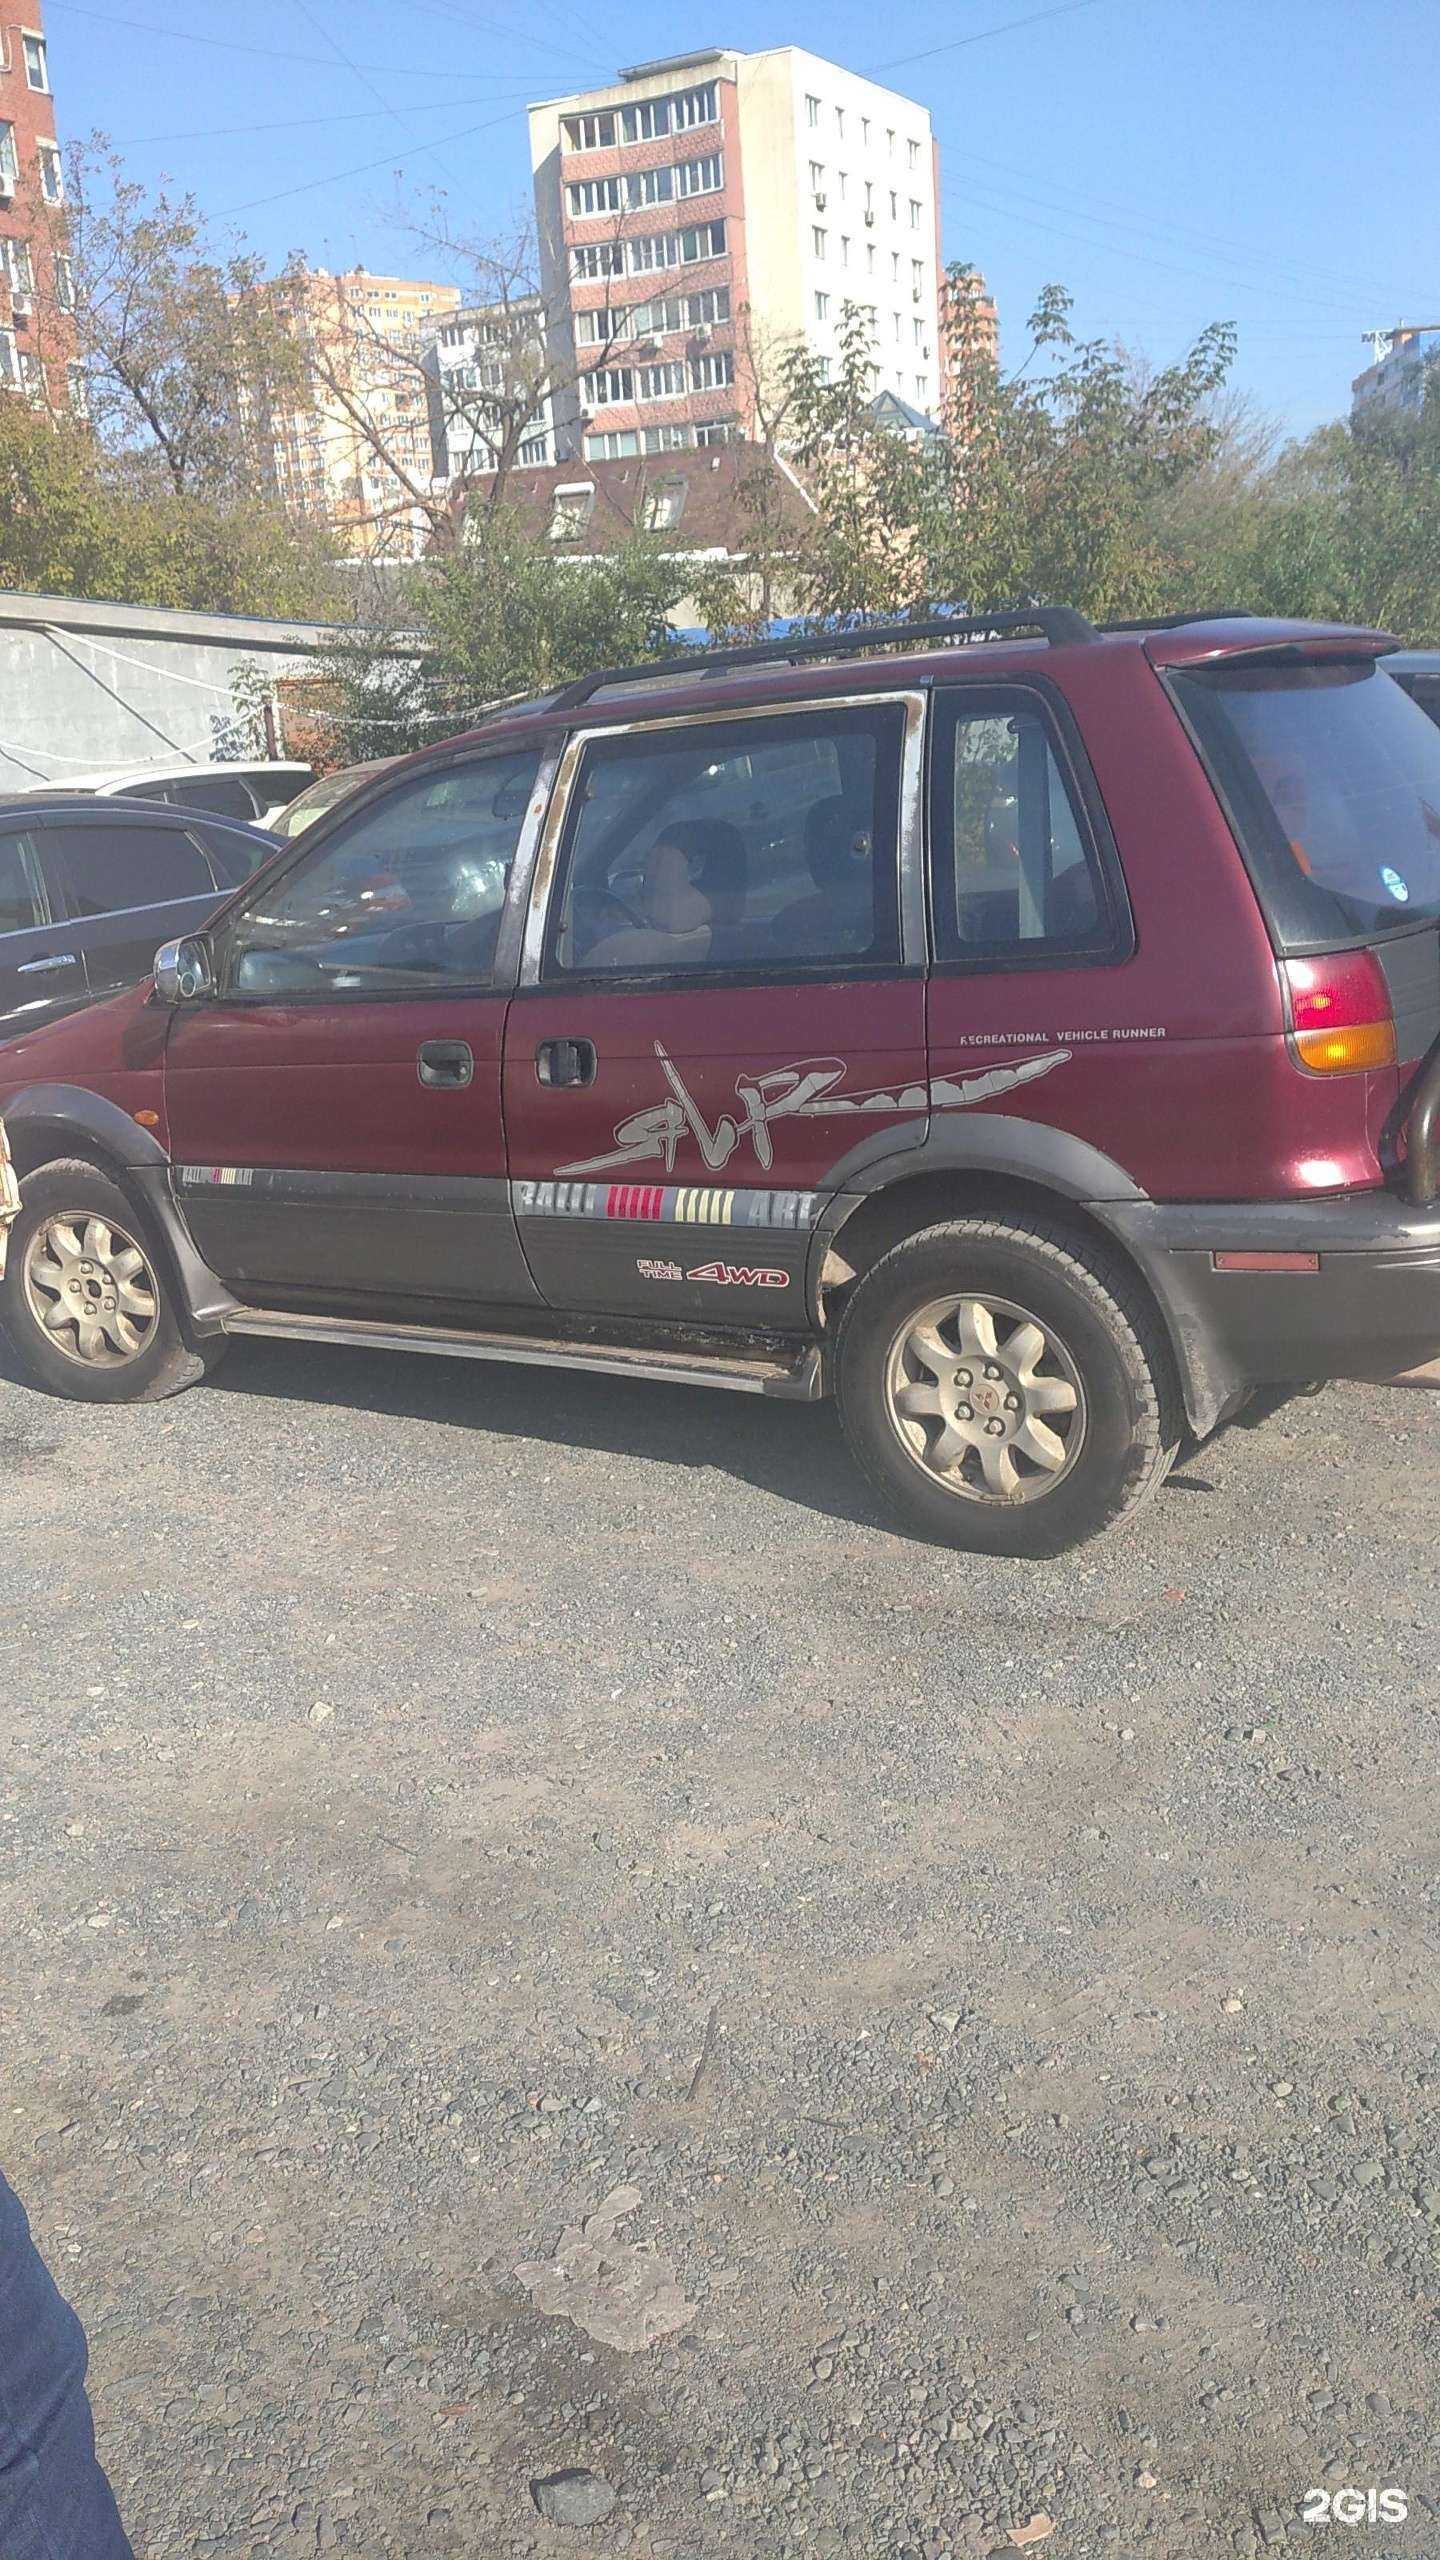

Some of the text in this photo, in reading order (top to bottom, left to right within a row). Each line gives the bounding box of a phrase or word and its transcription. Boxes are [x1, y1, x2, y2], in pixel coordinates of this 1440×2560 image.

[960, 1027, 1166, 1046] RECREATIONAL VEHICLE RUNNER
[636, 1259, 682, 1271] FULL
[638, 1268, 683, 1281] TIME
[686, 1261, 790, 1288] 4WD
